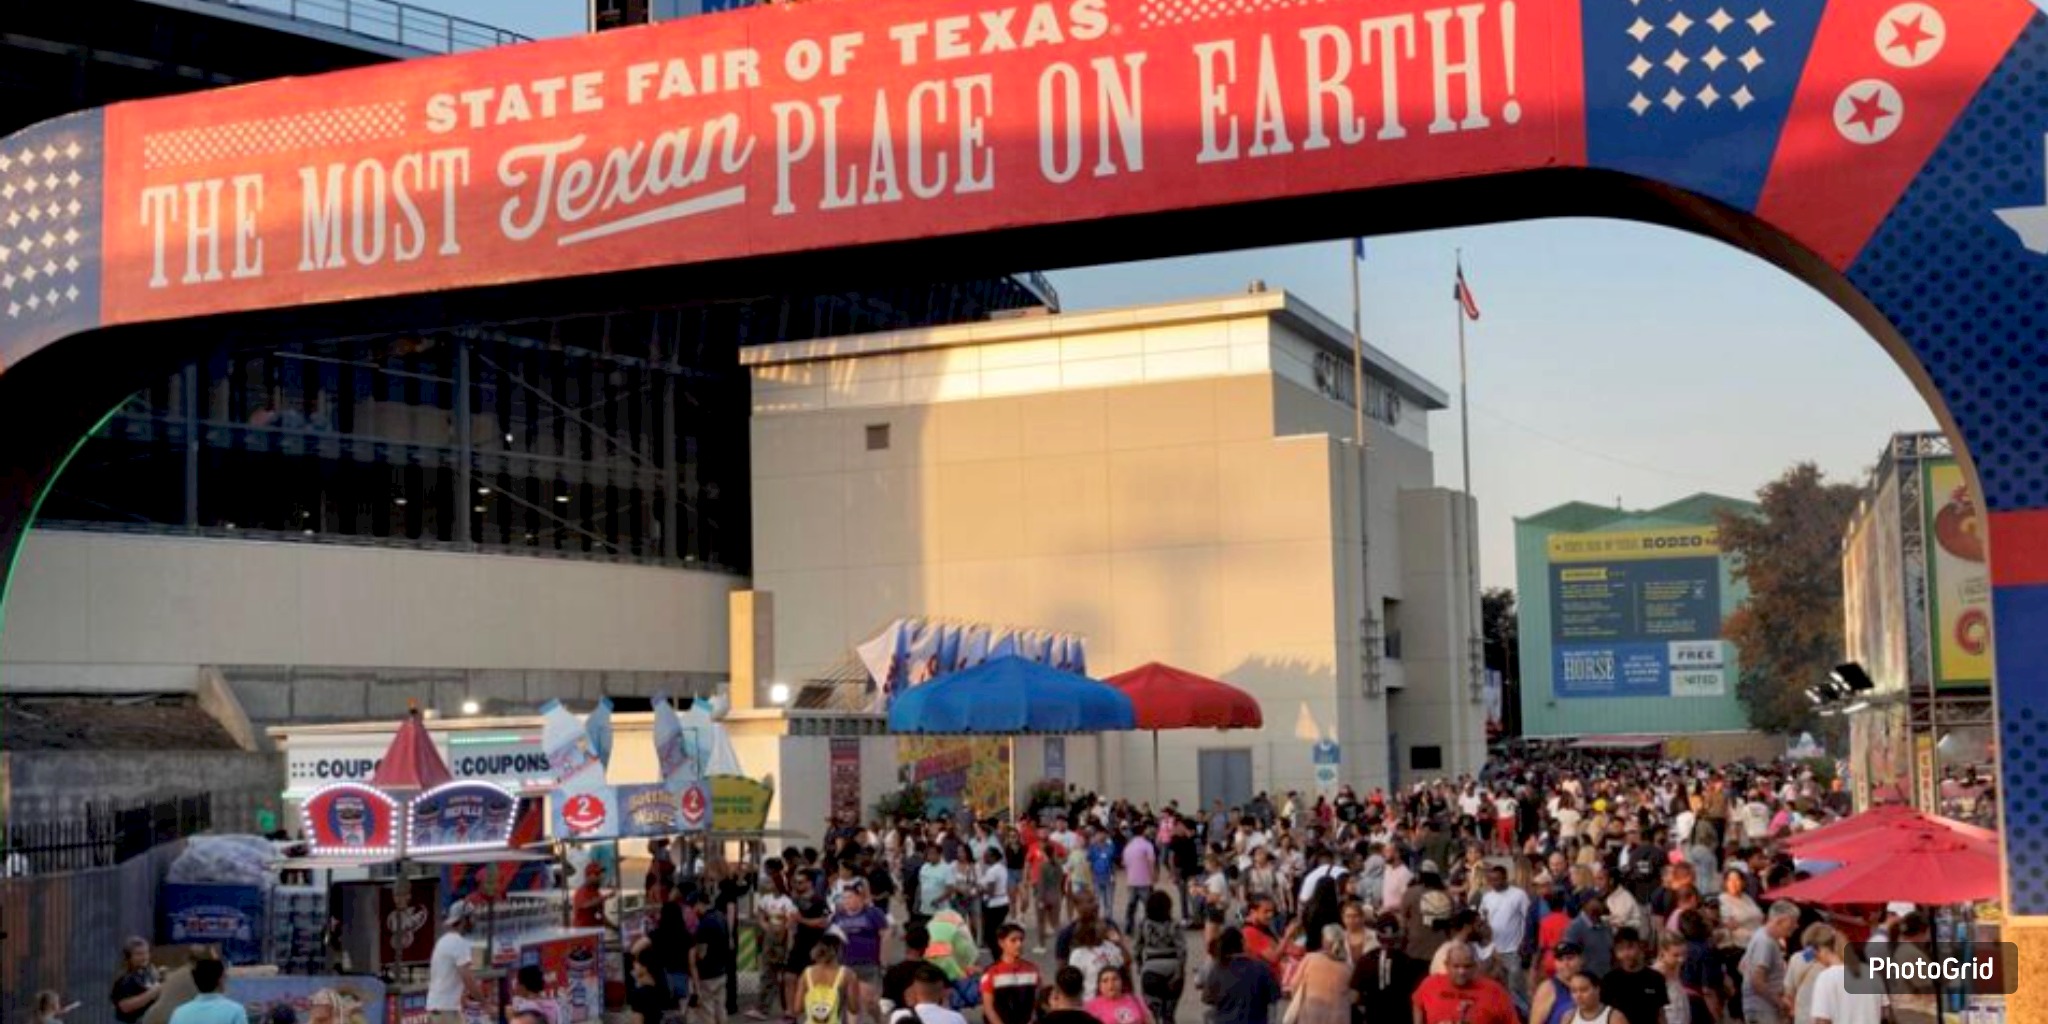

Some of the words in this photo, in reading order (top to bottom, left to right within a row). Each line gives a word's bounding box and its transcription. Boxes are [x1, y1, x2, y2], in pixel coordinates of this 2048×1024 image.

[426, 71, 605, 133] STATE
[627, 48, 761, 104] FAIR
[784, 33, 865, 82] OF
[888, 0, 1109, 66] TEXAS
[140, 173, 264, 289] THE
[298, 147, 470, 272] MOST
[497, 111, 756, 241] Texan
[771, 73, 994, 216] PLACE
[1037, 51, 1147, 184] ON
[1193, 1, 1523, 164] EARTH!
[1563, 656, 1615, 681] HORSE
[461, 753, 550, 776] COUPONS
[578, 798, 591, 816] 2
